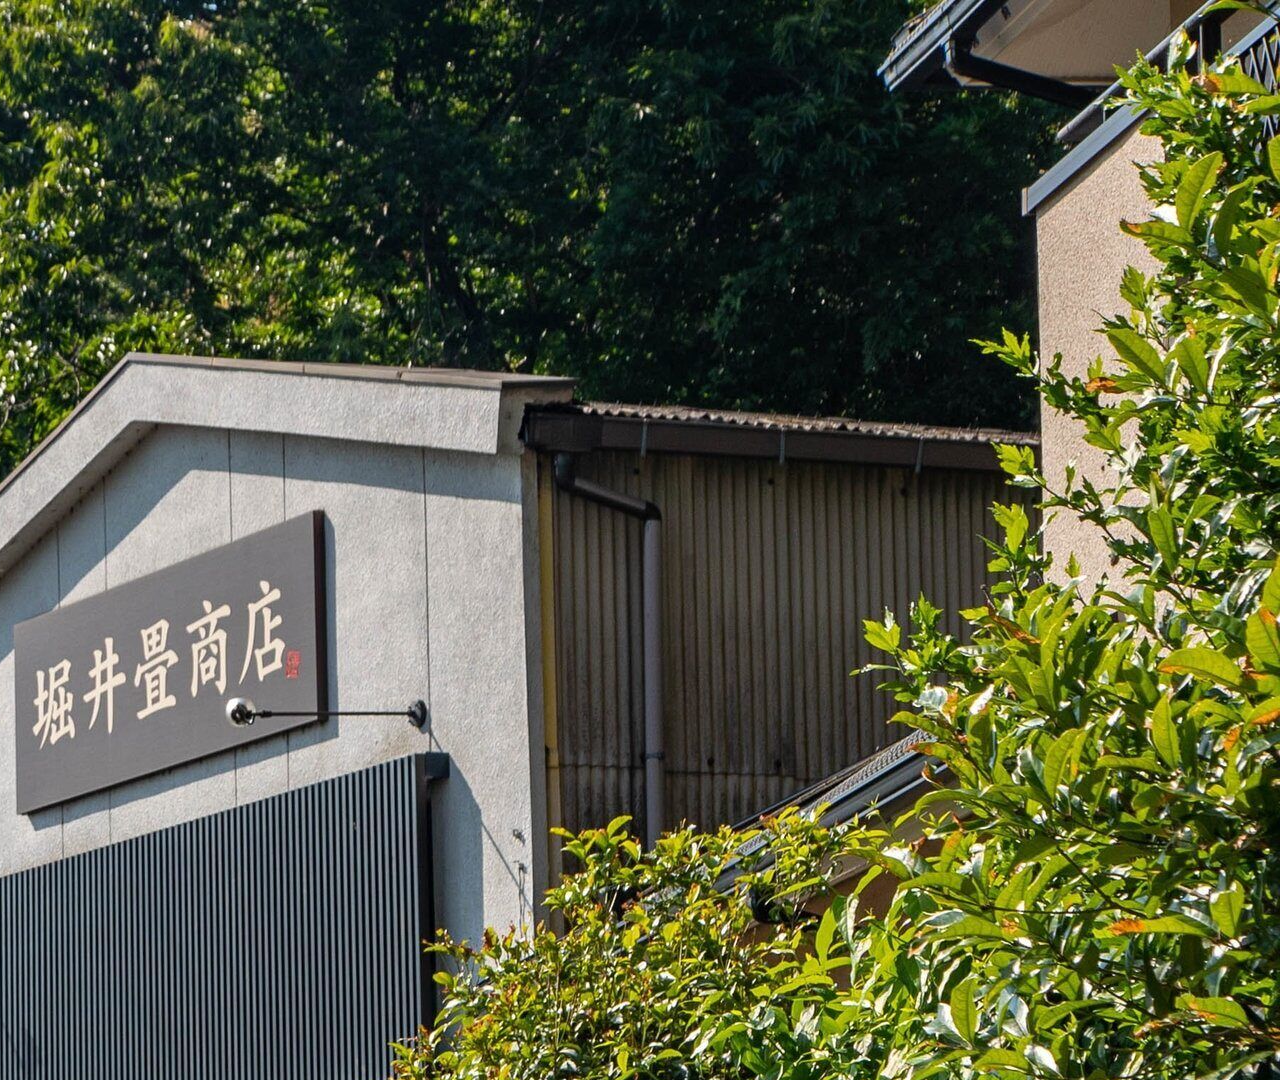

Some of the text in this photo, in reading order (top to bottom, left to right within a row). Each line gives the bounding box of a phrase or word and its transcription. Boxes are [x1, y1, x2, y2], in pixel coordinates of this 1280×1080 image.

[32, 580, 286, 750] 堀井畳商店
